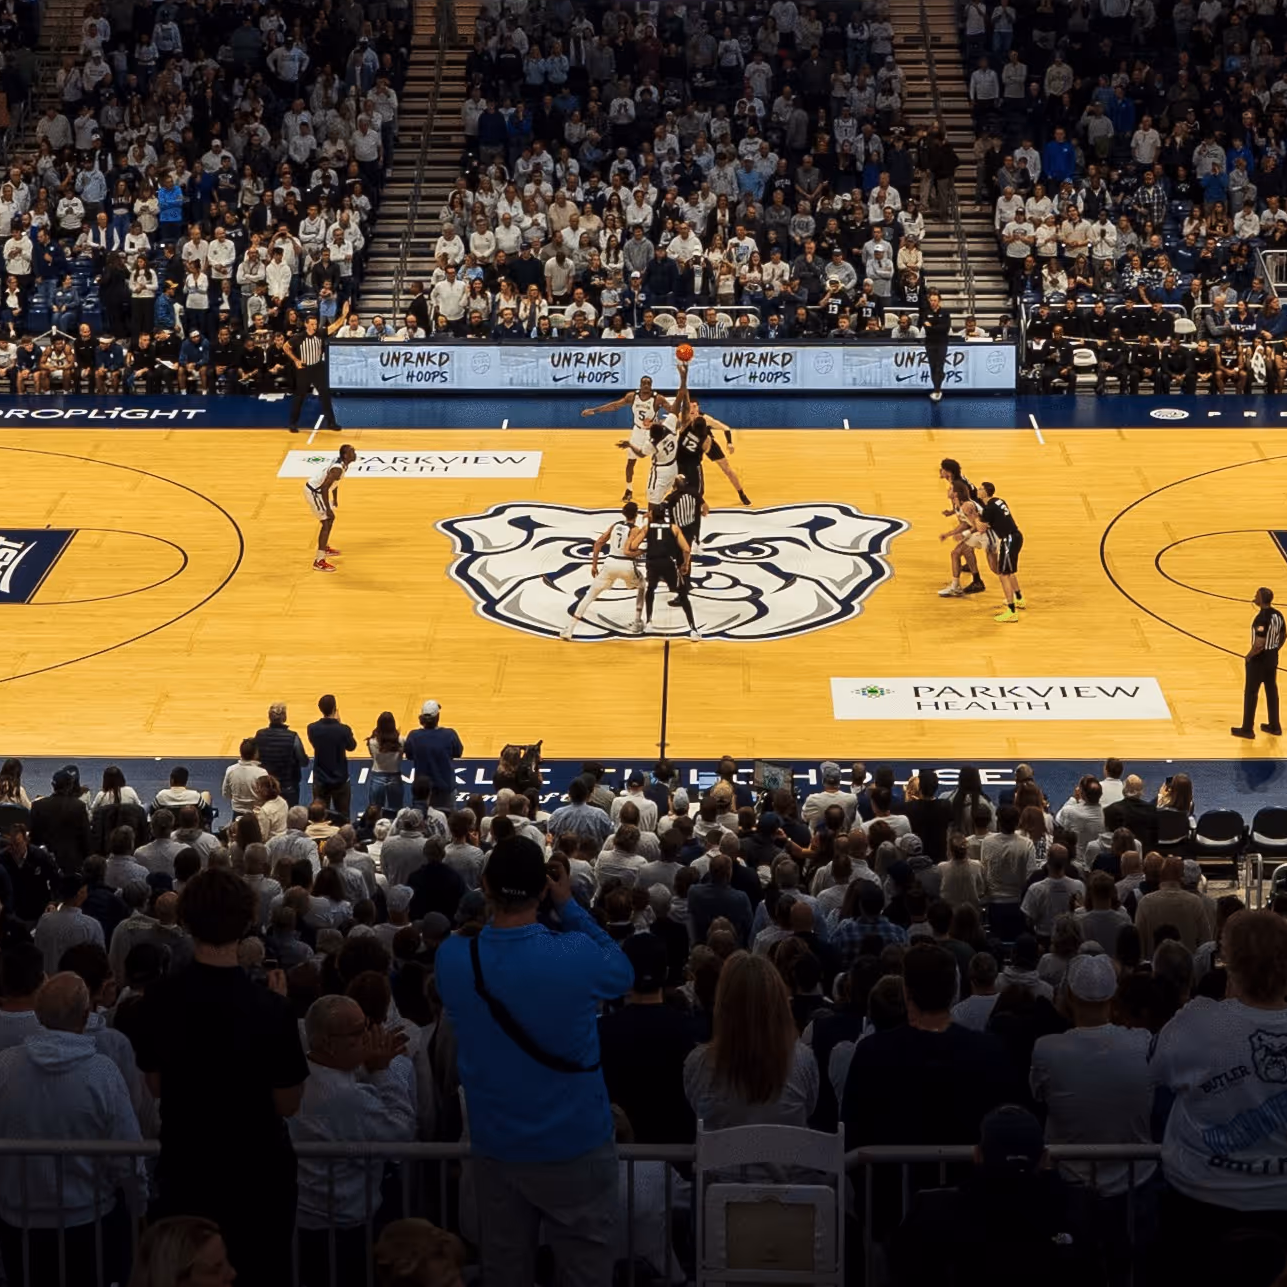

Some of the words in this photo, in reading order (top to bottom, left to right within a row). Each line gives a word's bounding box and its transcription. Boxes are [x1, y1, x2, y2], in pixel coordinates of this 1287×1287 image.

[380, 351, 450, 368] UNRNKD
[552, 351, 622, 368] UNRNKD
[723, 351, 793, 368] UNRNKD
[406, 371, 448, 383] HOOPS
[578, 371, 620, 383] HOOPS
[749, 371, 791, 383] HOOPS
[638, 410, 645, 421] 5
[663, 441, 675, 455] 13
[657, 528, 662, 540] 1
[913, 686, 1140, 698] PARKVIEW
[916, 702, 1051, 710] HEALTH
[1200, 1066, 1251, 1093] BUTLER
